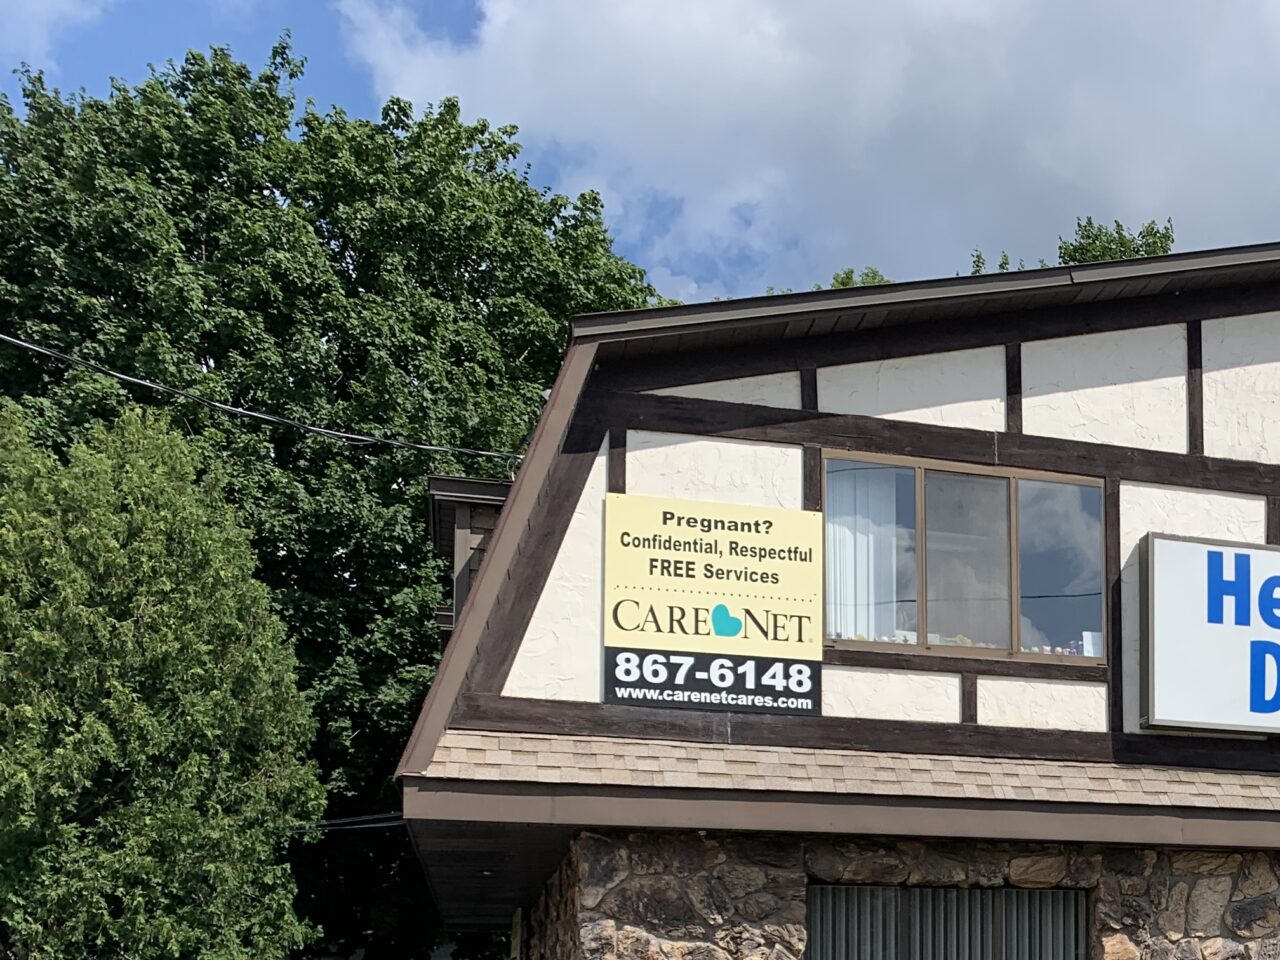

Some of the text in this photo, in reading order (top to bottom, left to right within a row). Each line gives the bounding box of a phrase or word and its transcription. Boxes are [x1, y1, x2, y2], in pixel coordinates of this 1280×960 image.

[662, 511, 773, 534] Pregnant?
[620, 532, 812, 562] Confidential, Respectful
[649, 558, 779, 584] FREE Services
[612, 599, 811, 644] CARE NET
[615, 652, 812, 693] 867-6148
[615, 687, 812, 709] www.carenetcares.com
